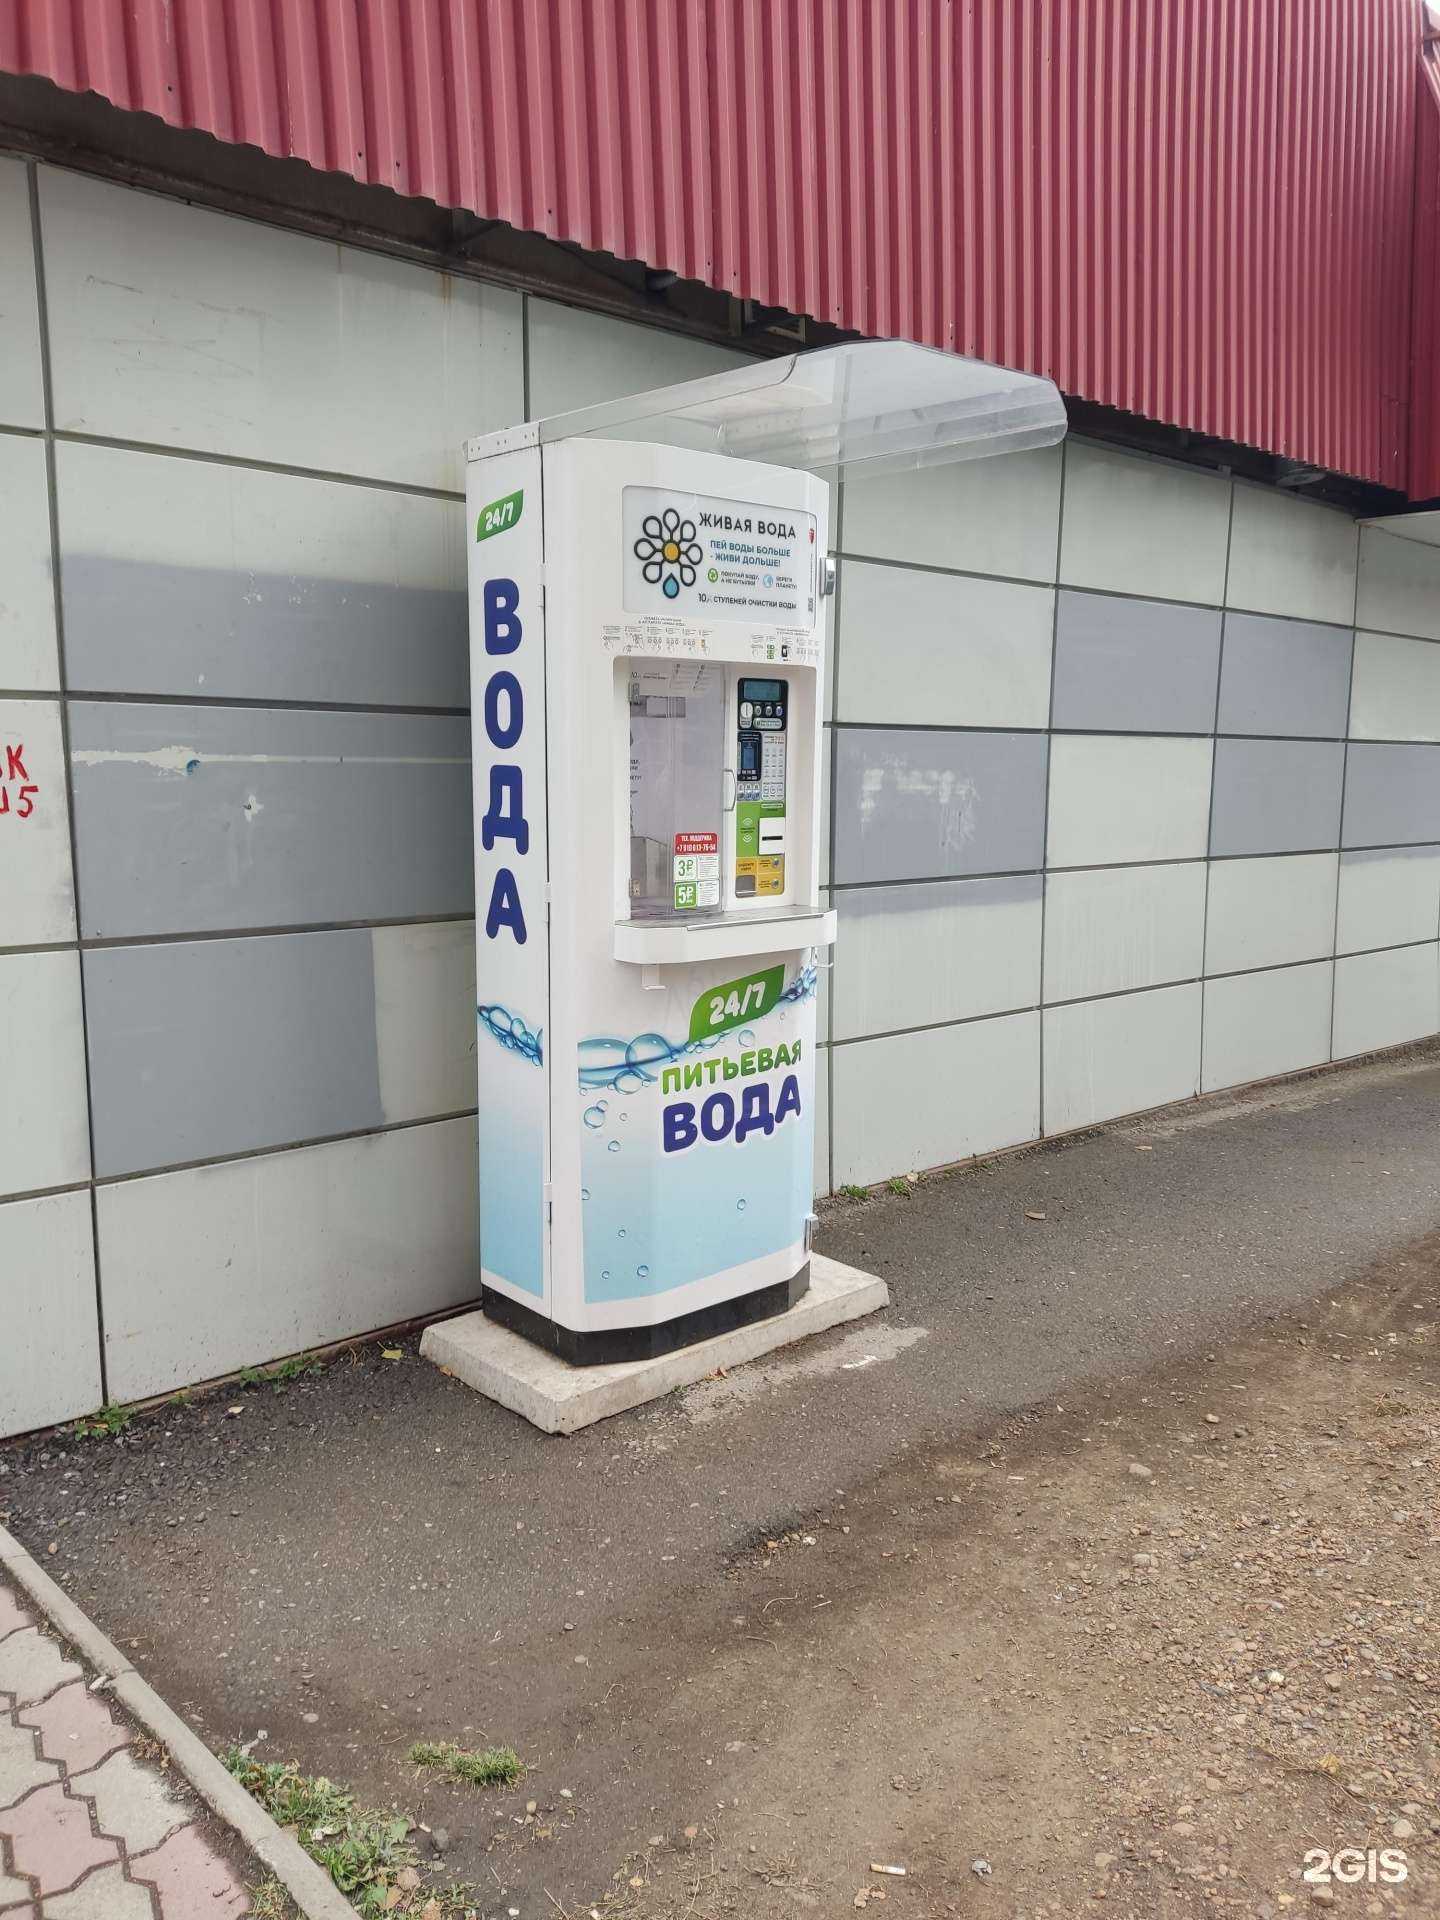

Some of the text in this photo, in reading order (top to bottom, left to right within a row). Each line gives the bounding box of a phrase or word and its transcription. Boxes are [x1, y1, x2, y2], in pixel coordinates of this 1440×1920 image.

[485, 501, 514, 531] 24/7
[699, 512, 796, 539] ЖИВАЯ ВОДА
[710, 540, 791, 557] ПЕЙ ВОДЫ БОЛЬШЕ
[715, 552, 740, 563] ЖИВИ
[742, 556, 781, 567] ДОЛЬШЕ!
[714, 595, 747, 606] СТУПЕНЕЙ
[748, 598, 778, 608] ОЧИСТКИ
[779, 600, 797, 610] ВОДЫ
[482, 578, 529, 945] ВОДА
[709, 981, 766, 1026] 24/7
[662, 1038, 801, 1095] ПИТЬЕВАЯ
[663, 1074, 801, 1153] ВОДА
